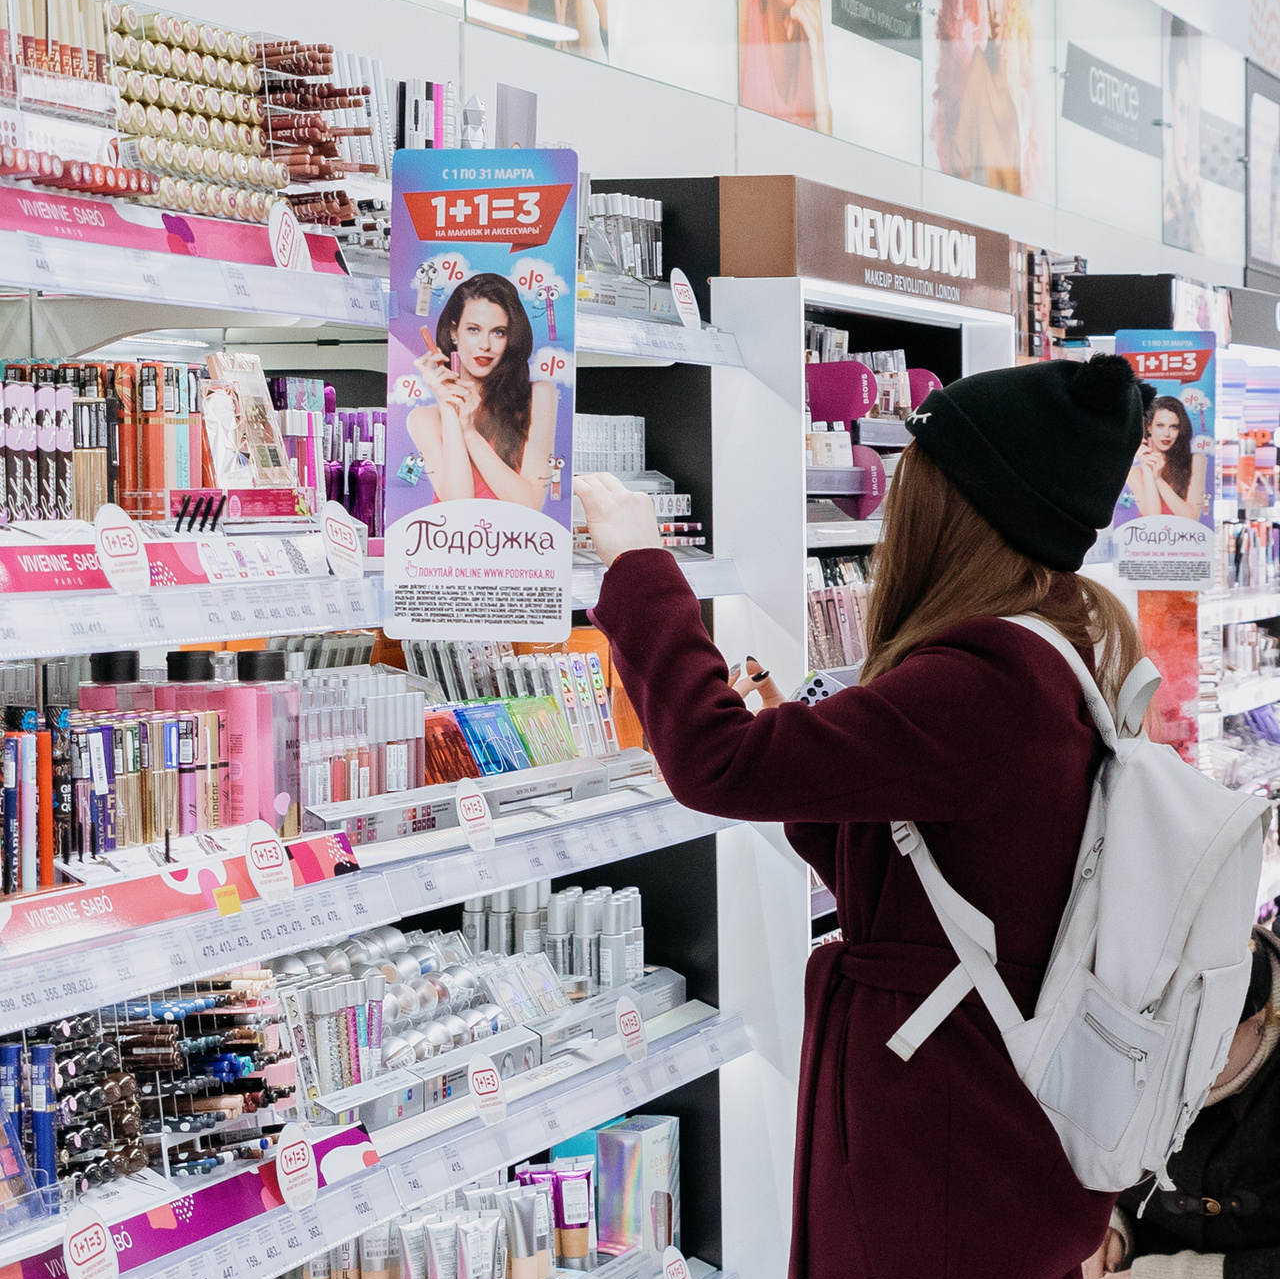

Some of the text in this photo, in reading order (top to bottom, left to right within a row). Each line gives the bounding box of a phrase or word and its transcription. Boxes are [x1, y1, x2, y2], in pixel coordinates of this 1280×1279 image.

[443, 169, 534, 179] С 1 ПО 31 МАРТА
[17, 198, 72, 224] VIVIENNE
[431, 192, 540, 227] 1+1=3
[54, 226, 83, 237] PARIS
[279, 221, 292, 259] 1+1=3
[435, 229, 446, 237] НА
[448, 229, 482, 237] МАКИЯЖ
[845, 204, 977, 279] REVOLUTION
[864, 268, 960, 302] MAKEUP REVOLUTION LONDON
[1136, 353, 1196, 372] 1+1=3
[862, 373, 870, 404] BROWS
[104, 531, 134, 552] 1+1=3
[329, 523, 354, 546] 1+1=3
[405, 515, 556, 556] Подружка
[1124, 524, 1206, 546] Подружка
[18, 554, 72, 573] VIVIENNE
[419, 566, 555, 579] ПОКУПАЙ ONLINE WWW.PODRYGKA.RU
[54, 577, 83, 586] PARIS
[463, 799, 483, 817] 1+1=3
[254, 839, 279, 864] 1+1=3
[24, 890, 113, 930] VIVIENNE SABÓ
[282, 1146, 307, 1169] 1+1=3
[72, 1230, 103, 1257] 1+1=3
